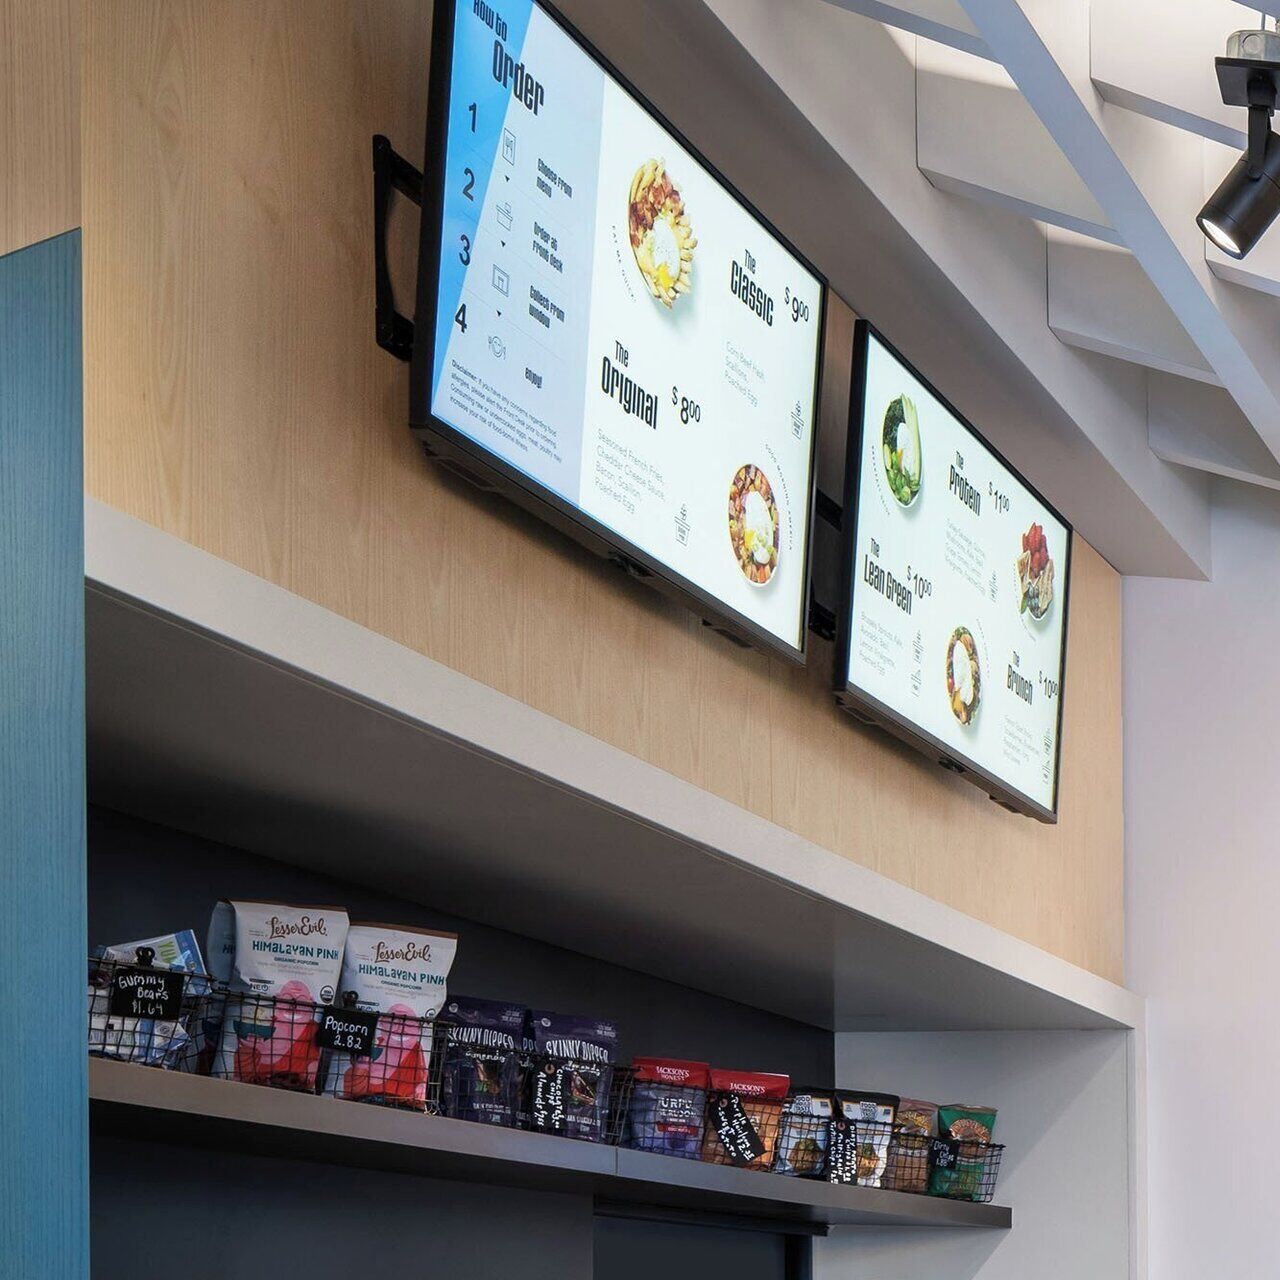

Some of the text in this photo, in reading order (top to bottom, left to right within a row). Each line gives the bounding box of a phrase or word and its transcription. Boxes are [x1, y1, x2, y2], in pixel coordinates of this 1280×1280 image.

[492, 39, 545, 116] Order
[468, 102, 477, 133] 1
[462, 167, 475, 201] 2
[459, 234, 471, 266] 3
[745, 249, 756, 274] The
[731, 260, 774, 327] Classic
[455, 303, 467, 333] 4
[615, 340, 629, 368] The
[601, 356, 658, 430] Original
[956, 450, 965, 471] The
[949, 464, 981, 517] Protein
[870, 538, 880, 558] The
[863, 554, 912, 616] Lean Green
[1007, 664, 1033, 706] Brunch
[132, 1000, 163, 1015] $1.64
[137, 986, 169, 1001] Bears
[325, 1016, 369, 1036] Popcorn
[334, 1034, 362, 1050] 2.82
[546, 1040, 580, 1059] SKINNY
[730, 1082, 766, 1094] JACKSON'S
